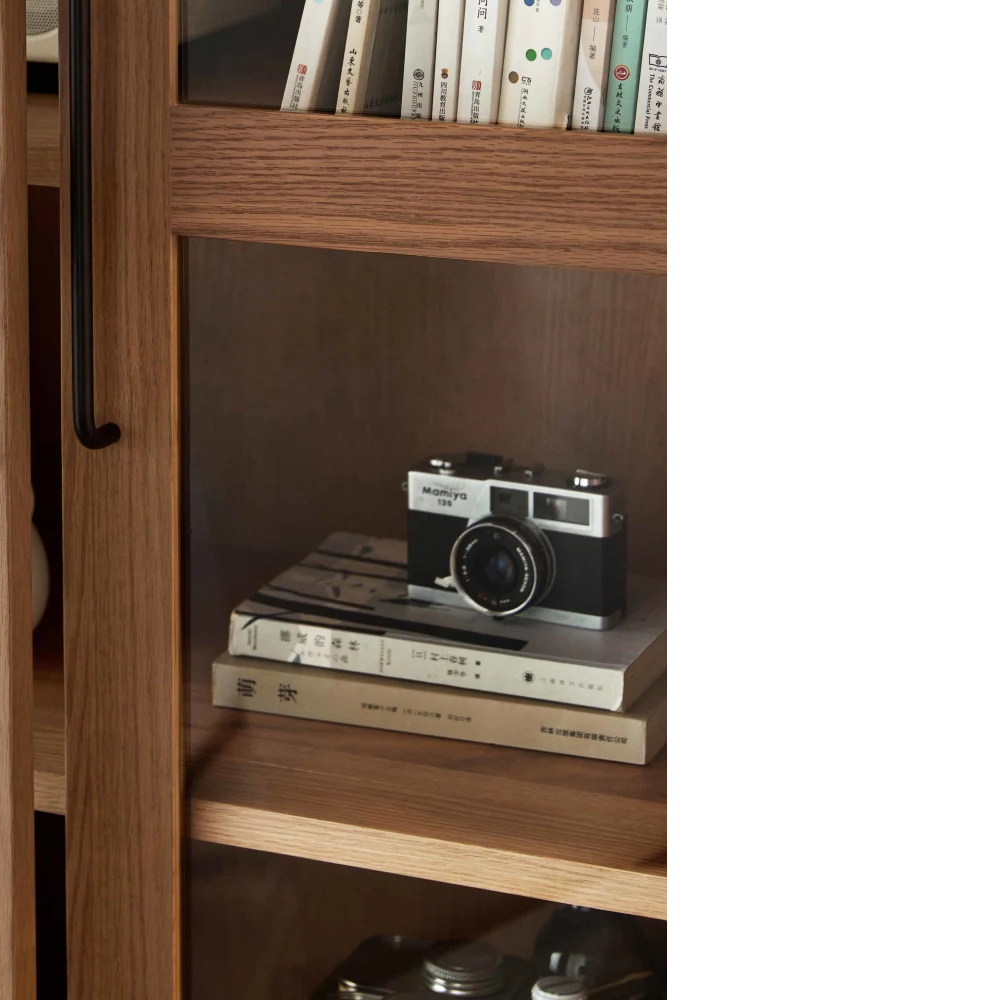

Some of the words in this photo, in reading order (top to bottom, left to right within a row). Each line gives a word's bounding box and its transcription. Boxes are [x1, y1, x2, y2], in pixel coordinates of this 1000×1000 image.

[339, 47, 358, 114] 山东文艺出版社
[645, 84, 654, 115] Commercial
[422, 486, 468, 501] Mamiya
[437, 498, 453, 508] 135
[279, 628, 360, 652] 挪威的森林
[236, 677, 298, 703] 萌芽
